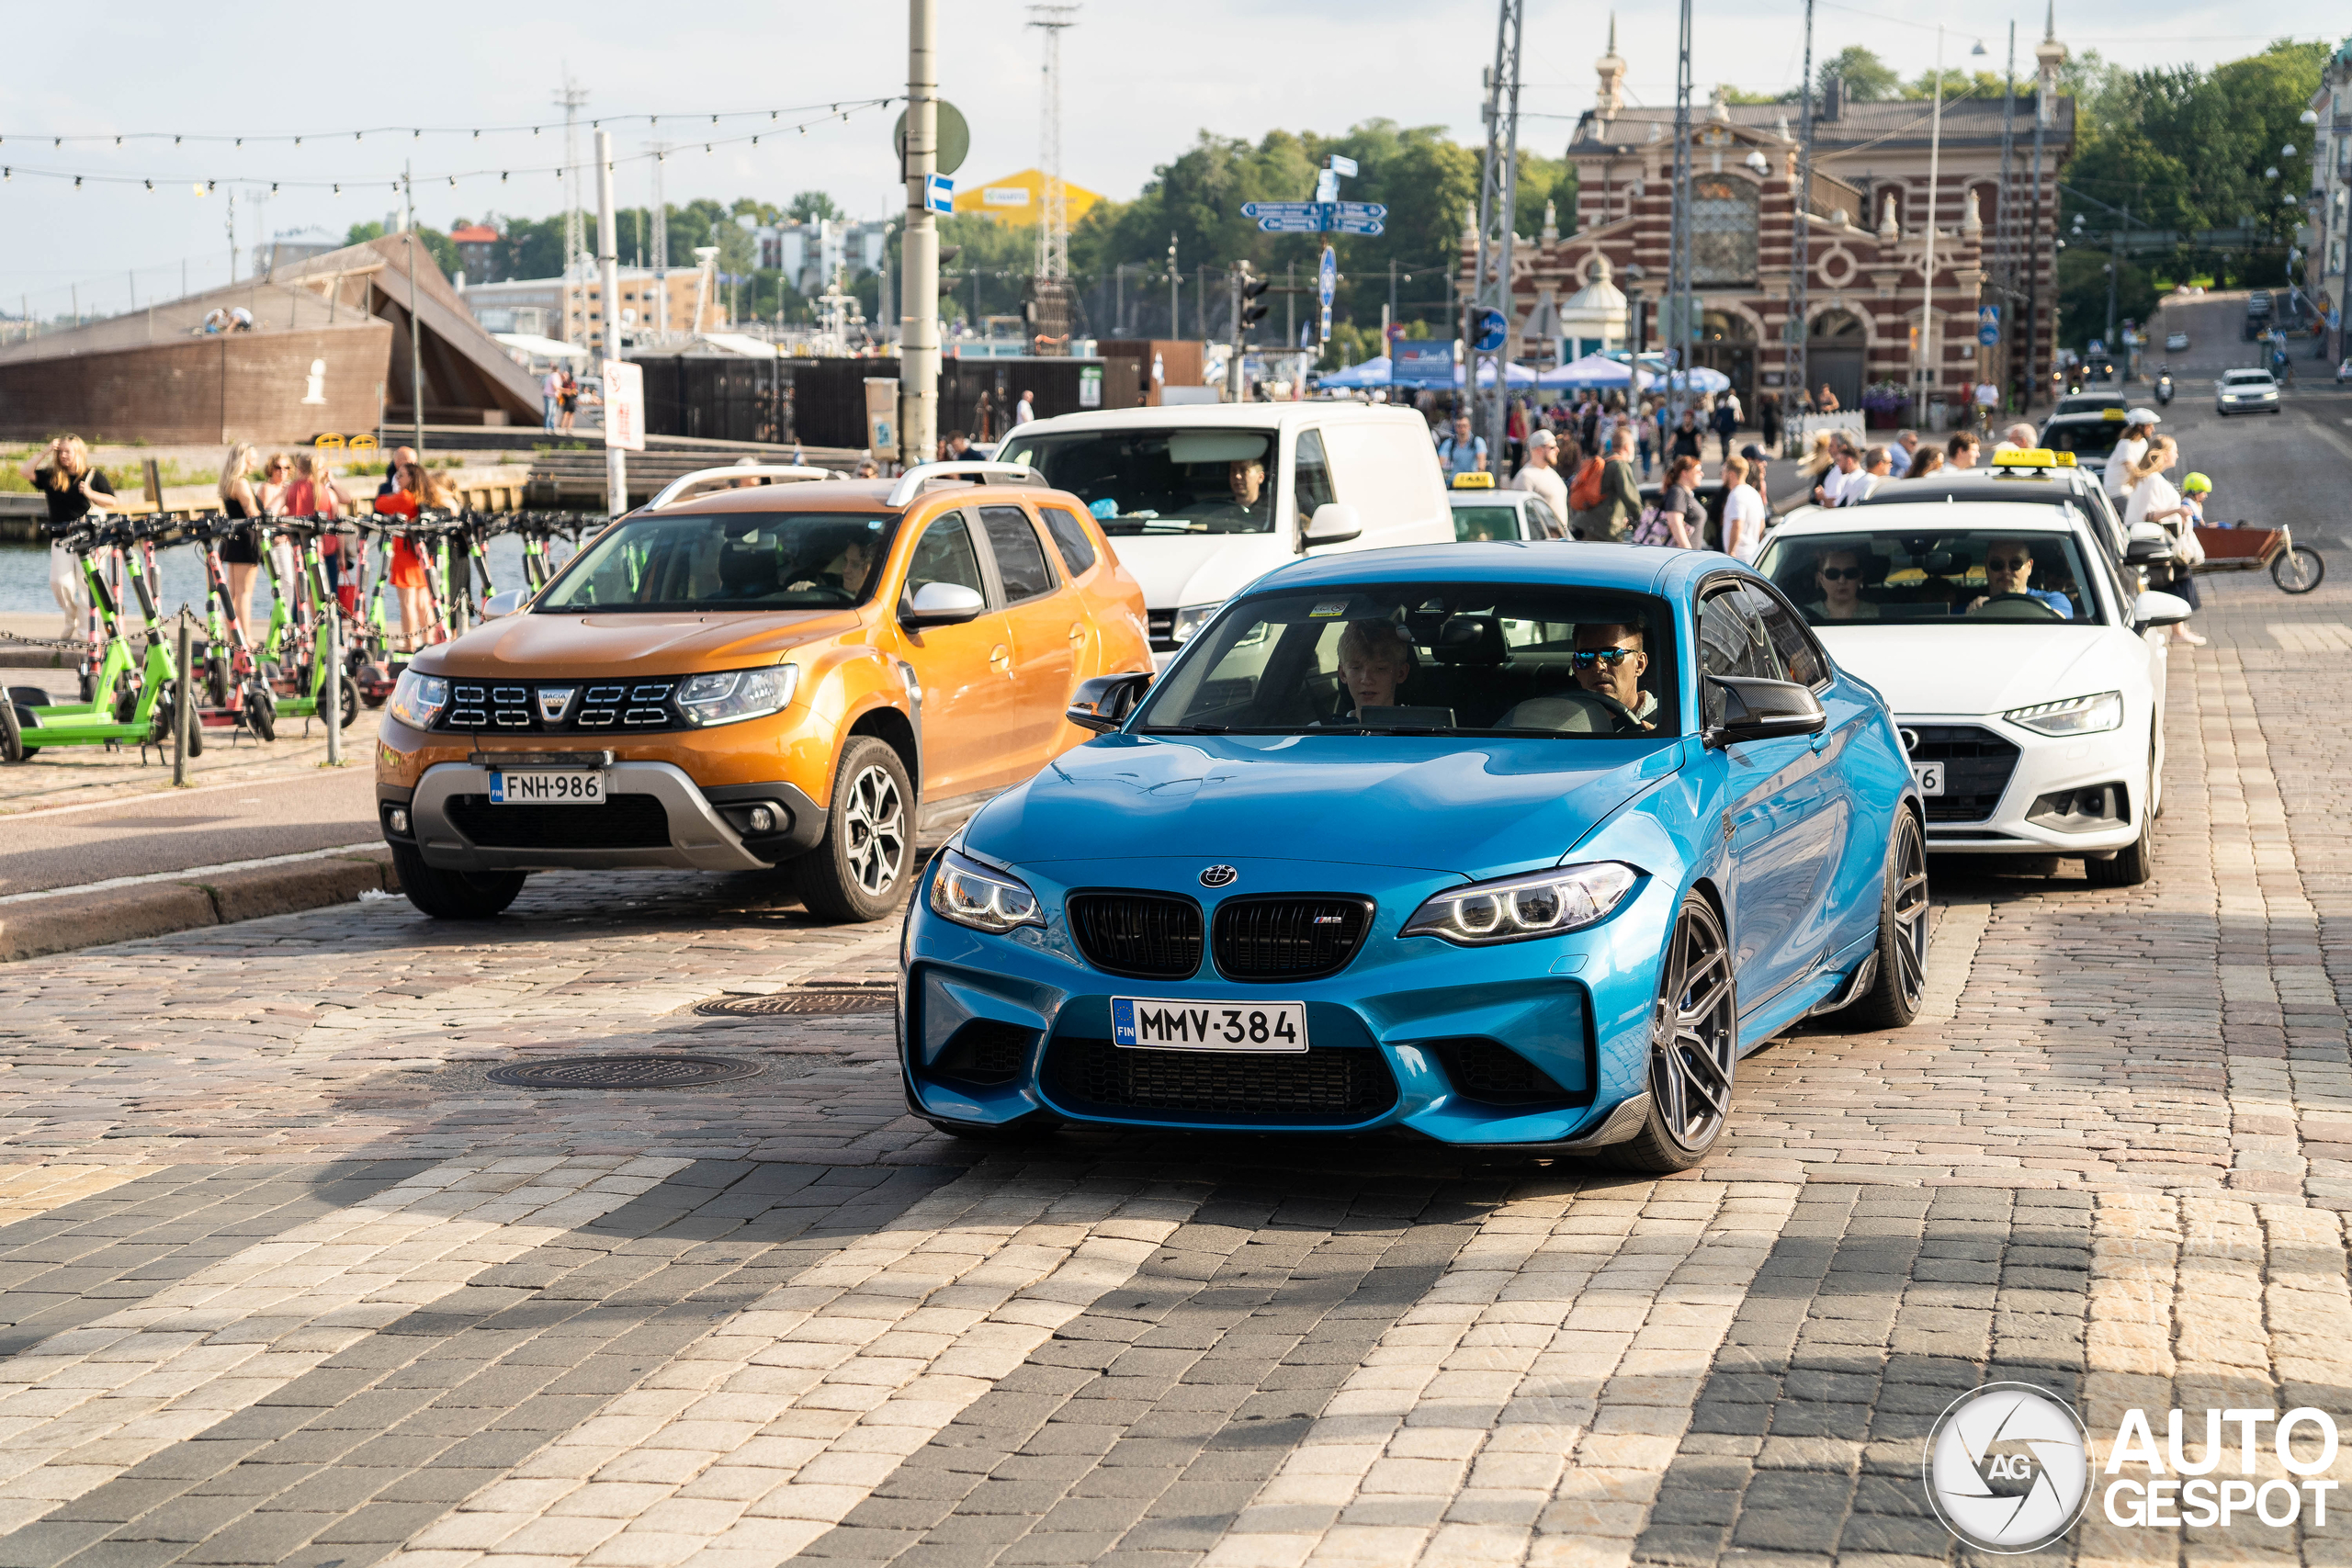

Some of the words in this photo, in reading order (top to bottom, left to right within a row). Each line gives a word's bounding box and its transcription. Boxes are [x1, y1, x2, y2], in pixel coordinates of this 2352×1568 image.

[507, 776, 598, 797] FNH-986
[1319, 916, 1342, 924] M2
[1117, 1026, 1135, 1037] FIN
[1140, 1008, 1296, 1043] MMV-384
